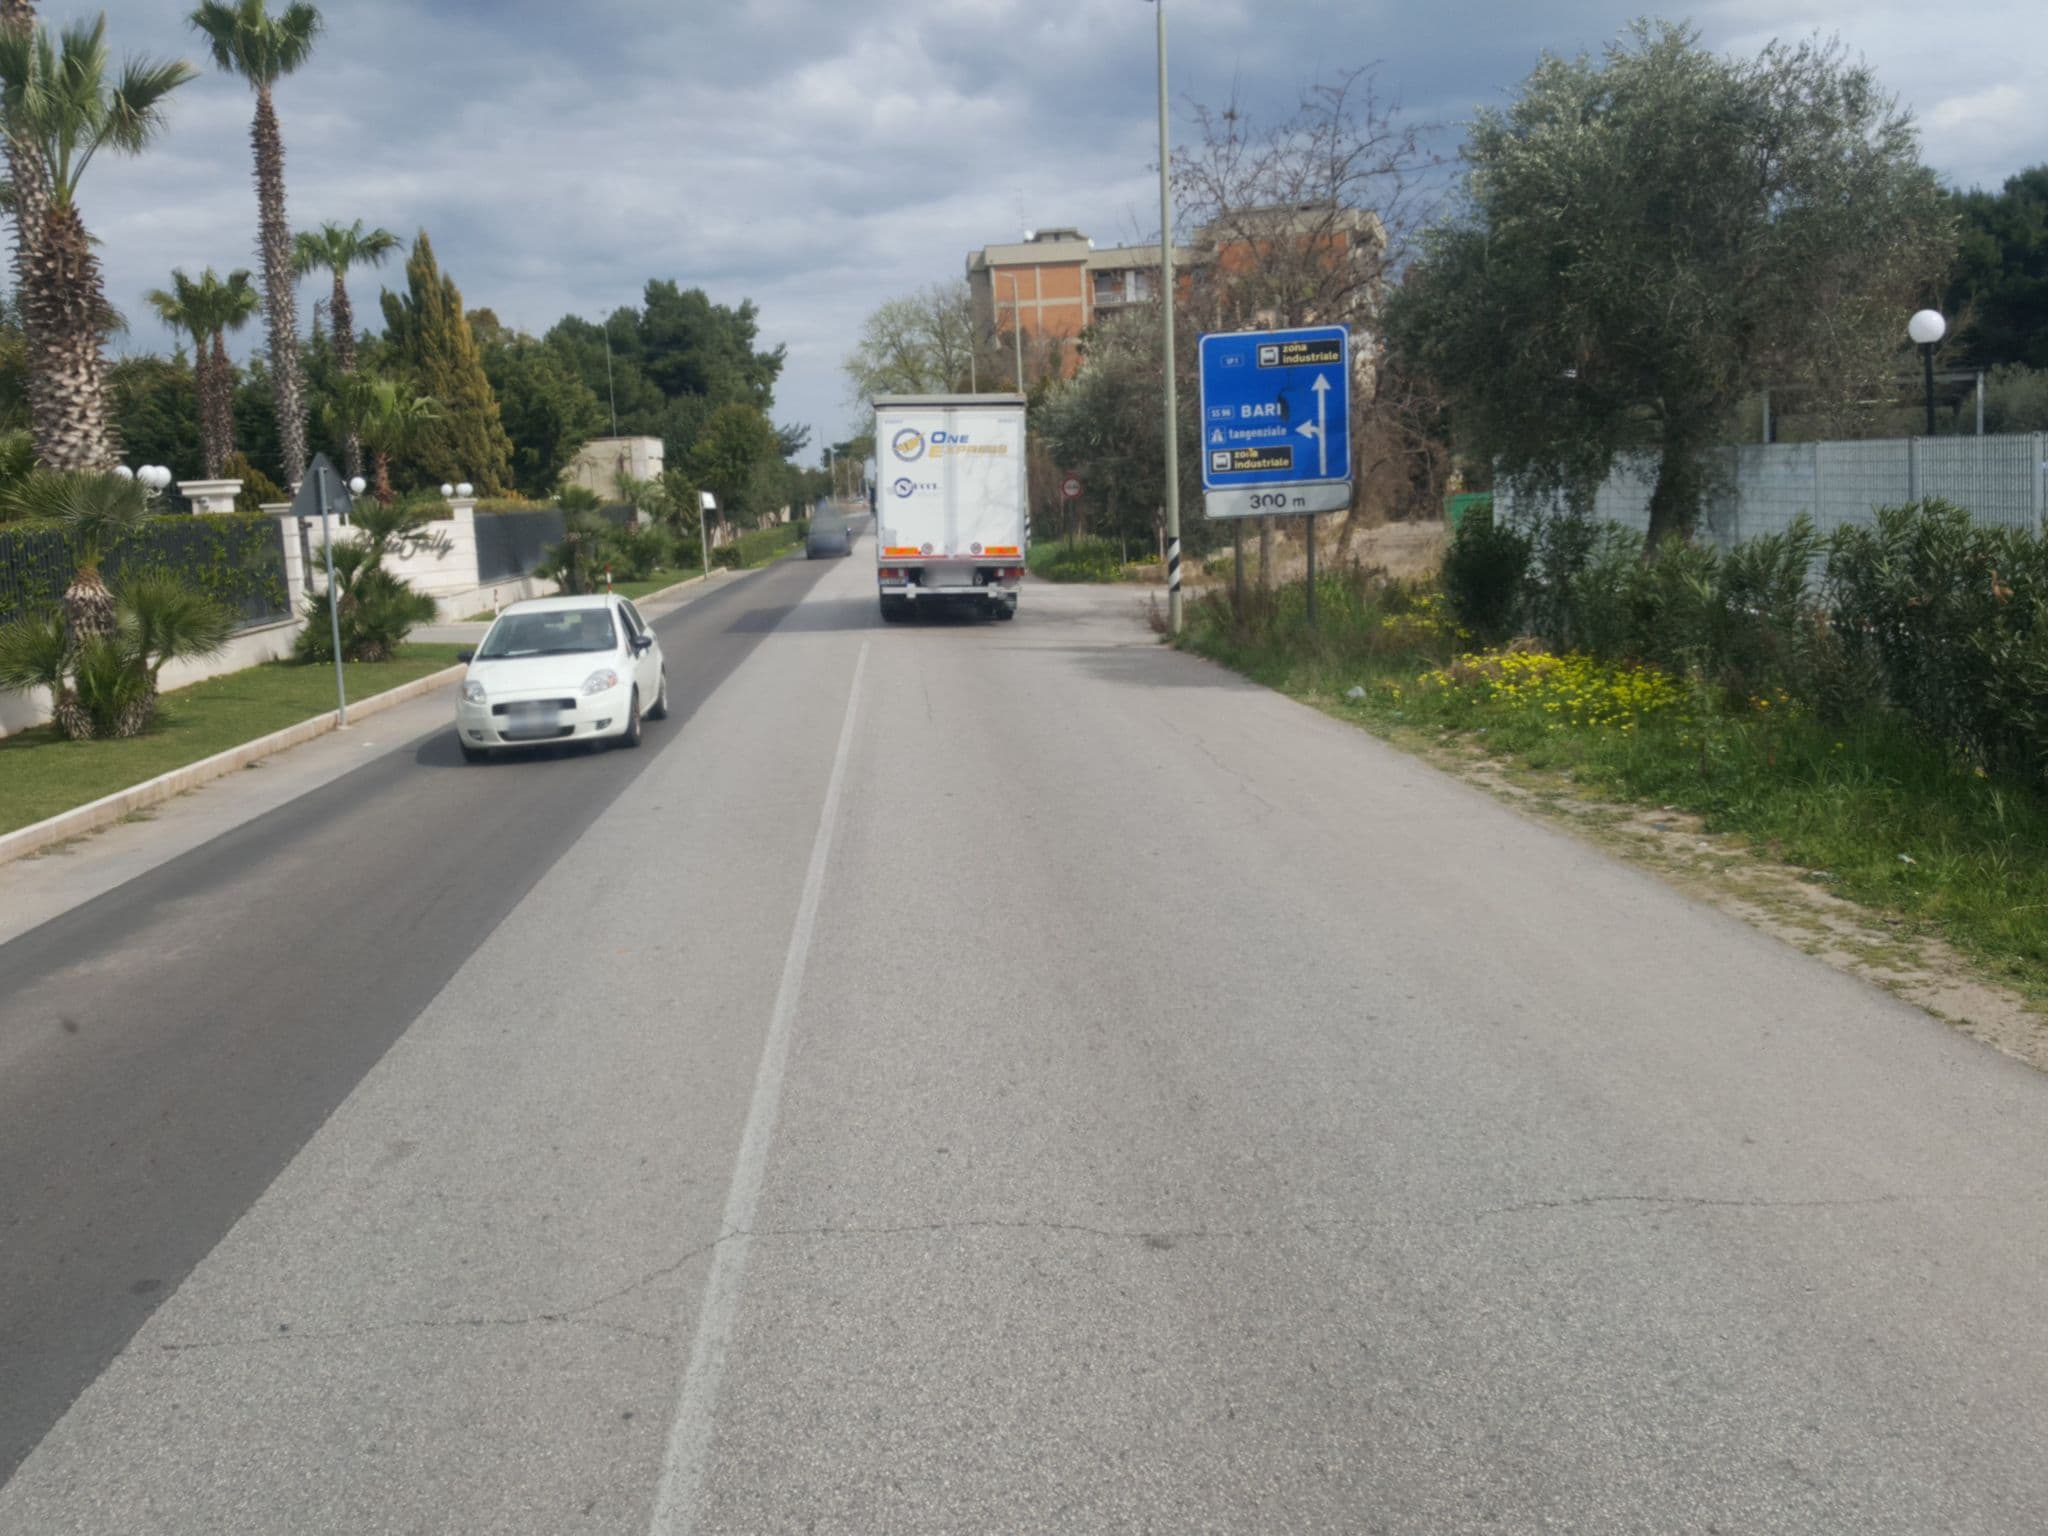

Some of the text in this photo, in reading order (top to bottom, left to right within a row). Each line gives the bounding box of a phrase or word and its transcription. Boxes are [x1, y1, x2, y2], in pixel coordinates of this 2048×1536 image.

[1283, 343, 1307, 353] zona
[1283, 352, 1339, 364] industriale
[1241, 403, 1281, 418] BARI
[1229, 425, 1287, 440] tangenziale
[1234, 449, 1258, 459] zona
[1234, 457, 1289, 470] industriale
[1249, 493, 1306, 509] 300 m
